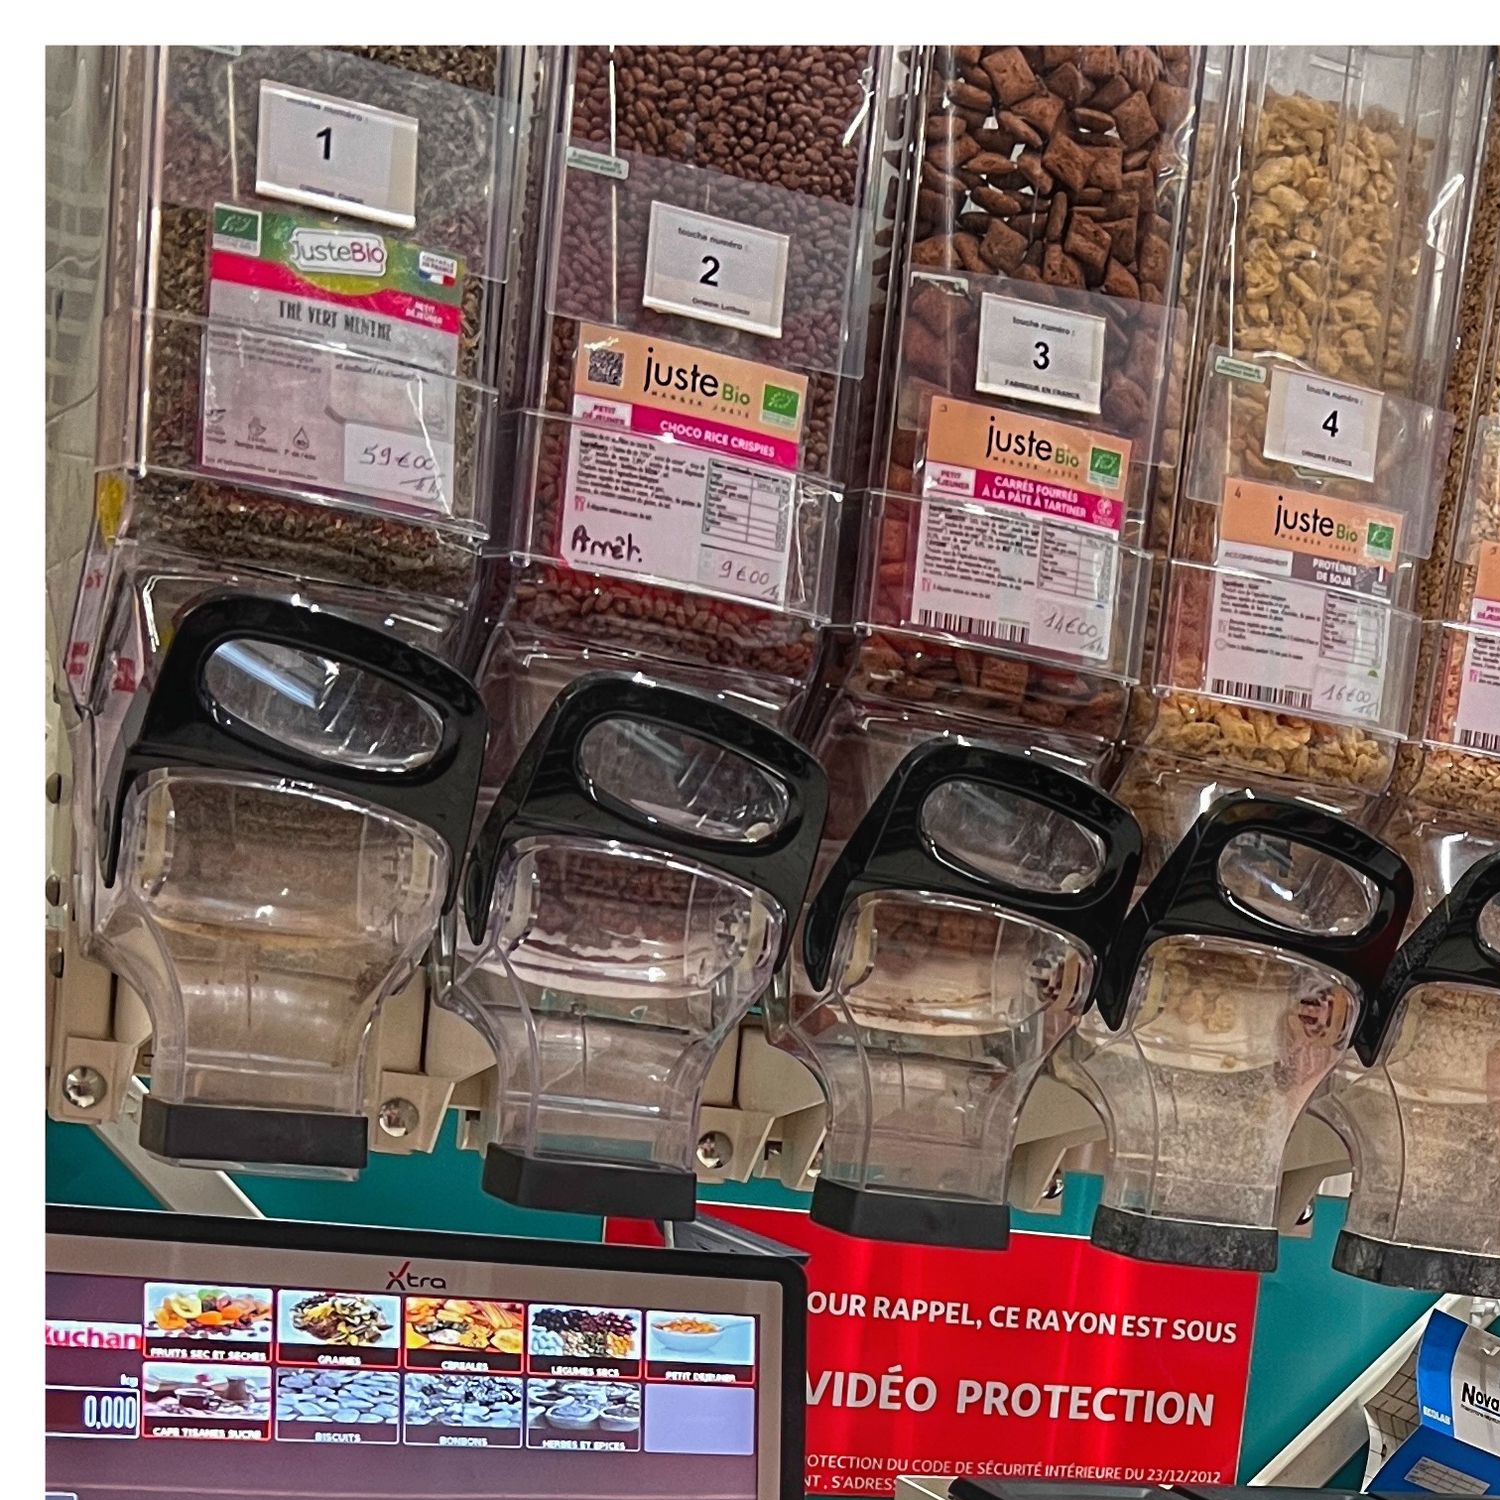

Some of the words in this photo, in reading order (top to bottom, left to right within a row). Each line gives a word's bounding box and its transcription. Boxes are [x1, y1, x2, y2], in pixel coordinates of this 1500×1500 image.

[316, 127, 332, 160] 1
[292, 239, 386, 264] JusteBio
[699, 255, 720, 287] 2
[308, 304, 337, 328] VERT
[1032, 341, 1051, 370] 3
[643, 346, 719, 398] juste
[722, 383, 751, 406] Bio
[592, 404, 617, 416] PETIT
[1321, 410, 1339, 438] 4
[659, 420, 702, 440] CHOCO
[704, 430, 728, 447] RICE
[730, 435, 775, 458] CRISPIES
[985, 415, 1053, 462] juste
[1055, 448, 1080, 468] Bio
[940, 469, 962, 480] PETIT
[981, 485, 990, 497] À
[992, 489, 1006, 500] LA
[1007, 489, 1033, 506] PÂTE
[1033, 494, 1042, 508] À
[1043, 498, 1087, 519] TARTINER
[994, 475, 1035, 494] CARRÉS
[1036, 483, 1079, 504] FOURRÉS
[1274, 495, 1334, 538] juste
[1336, 523, 1359, 543] Bio
[1312, 558, 1358, 576] PROTÉINES
[1316, 571, 1329, 582] DE
[1330, 574, 1353, 587] SOJA
[386, 1261, 447, 1291] Xtra
[806, 1291, 866, 1317] OUR
[873, 1296, 982, 1330] RAPPEL,
[988, 1305, 1020, 1329] CE
[1025, 1308, 1116, 1337] RAYON
[1121, 1315, 1167, 1338] EST
[1171, 1319, 1237, 1344] SOUS
[150, 1347, 188, 1359] FRUITS
[190, 1349, 211, 1360] SEC
[212, 1350, 226, 1360] ET
[317, 1354, 362, 1366] GRAINES
[441, 1360, 489, 1372] CEREALES
[551, 1366, 594, 1377] LEGUMES
[596, 1367, 620, 1378] SECS
[665, 1371, 691, 1382] PETIT
[805, 1364, 938, 1412] VIDÉO
[956, 1379, 1214, 1427] PROTECTION
[181, 1428, 226, 1438] TISANES
[227, 1429, 262, 1440] SUCRE
[314, 1431, 362, 1443] BISCUITS
[438, 1436, 488, 1447] BONBONS
[593, 1441, 626, 1451] EPICES
[805, 1454, 884, 1472] OTECTION
[887, 1459, 908, 1471] DU
[911, 1459, 951, 1474] CODE
[954, 1461, 974, 1475] DE
[976, 1459, 1042, 1477] SÉCURITÉ
[1045, 1462, 1122, 1480] INTÉRIEURE
[1124, 1468, 1144, 1481] DU
[1146, 1467, 1221, 1484] 23/12/2012
